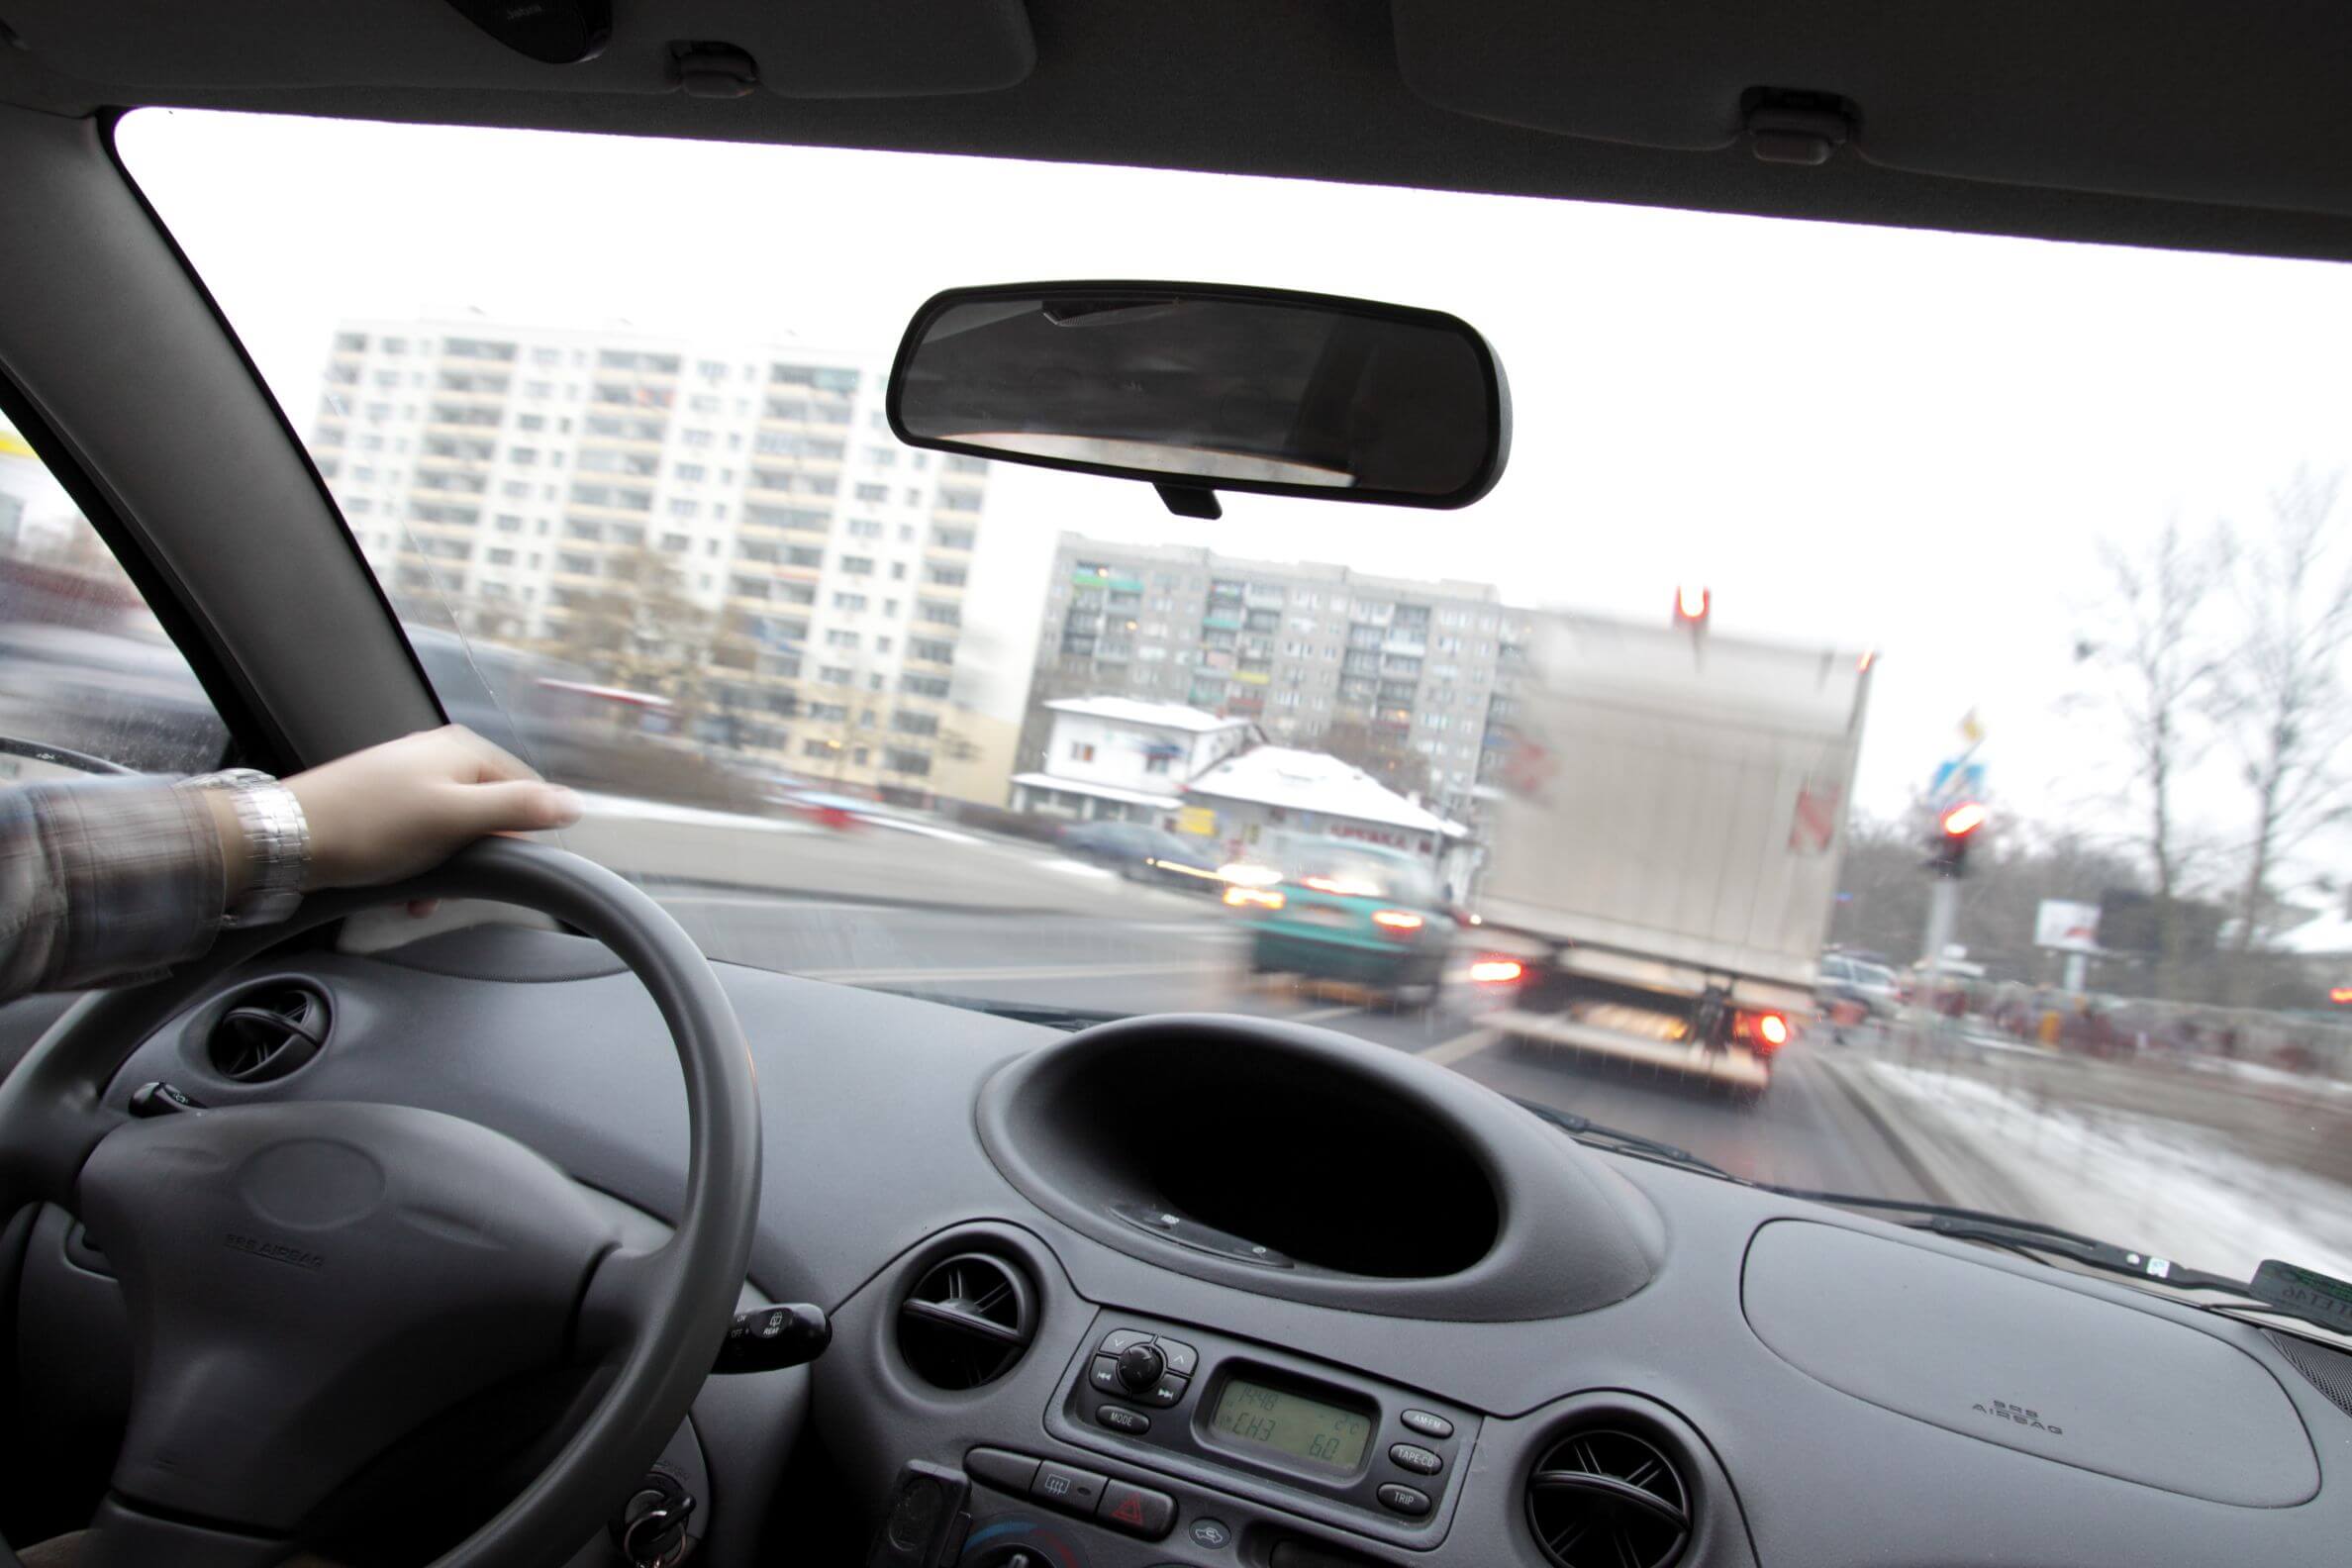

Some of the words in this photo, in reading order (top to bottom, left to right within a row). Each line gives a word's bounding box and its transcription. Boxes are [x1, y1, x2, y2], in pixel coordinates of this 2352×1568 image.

[1112, 1412, 1133, 1426] MODE
[1972, 1404, 2064, 1435] AIRBAG
[1994, 1400, 2039, 1420] SRS
[1310, 1433, 1339, 1461] 60
[1394, 1491, 1415, 1506] TRIP
